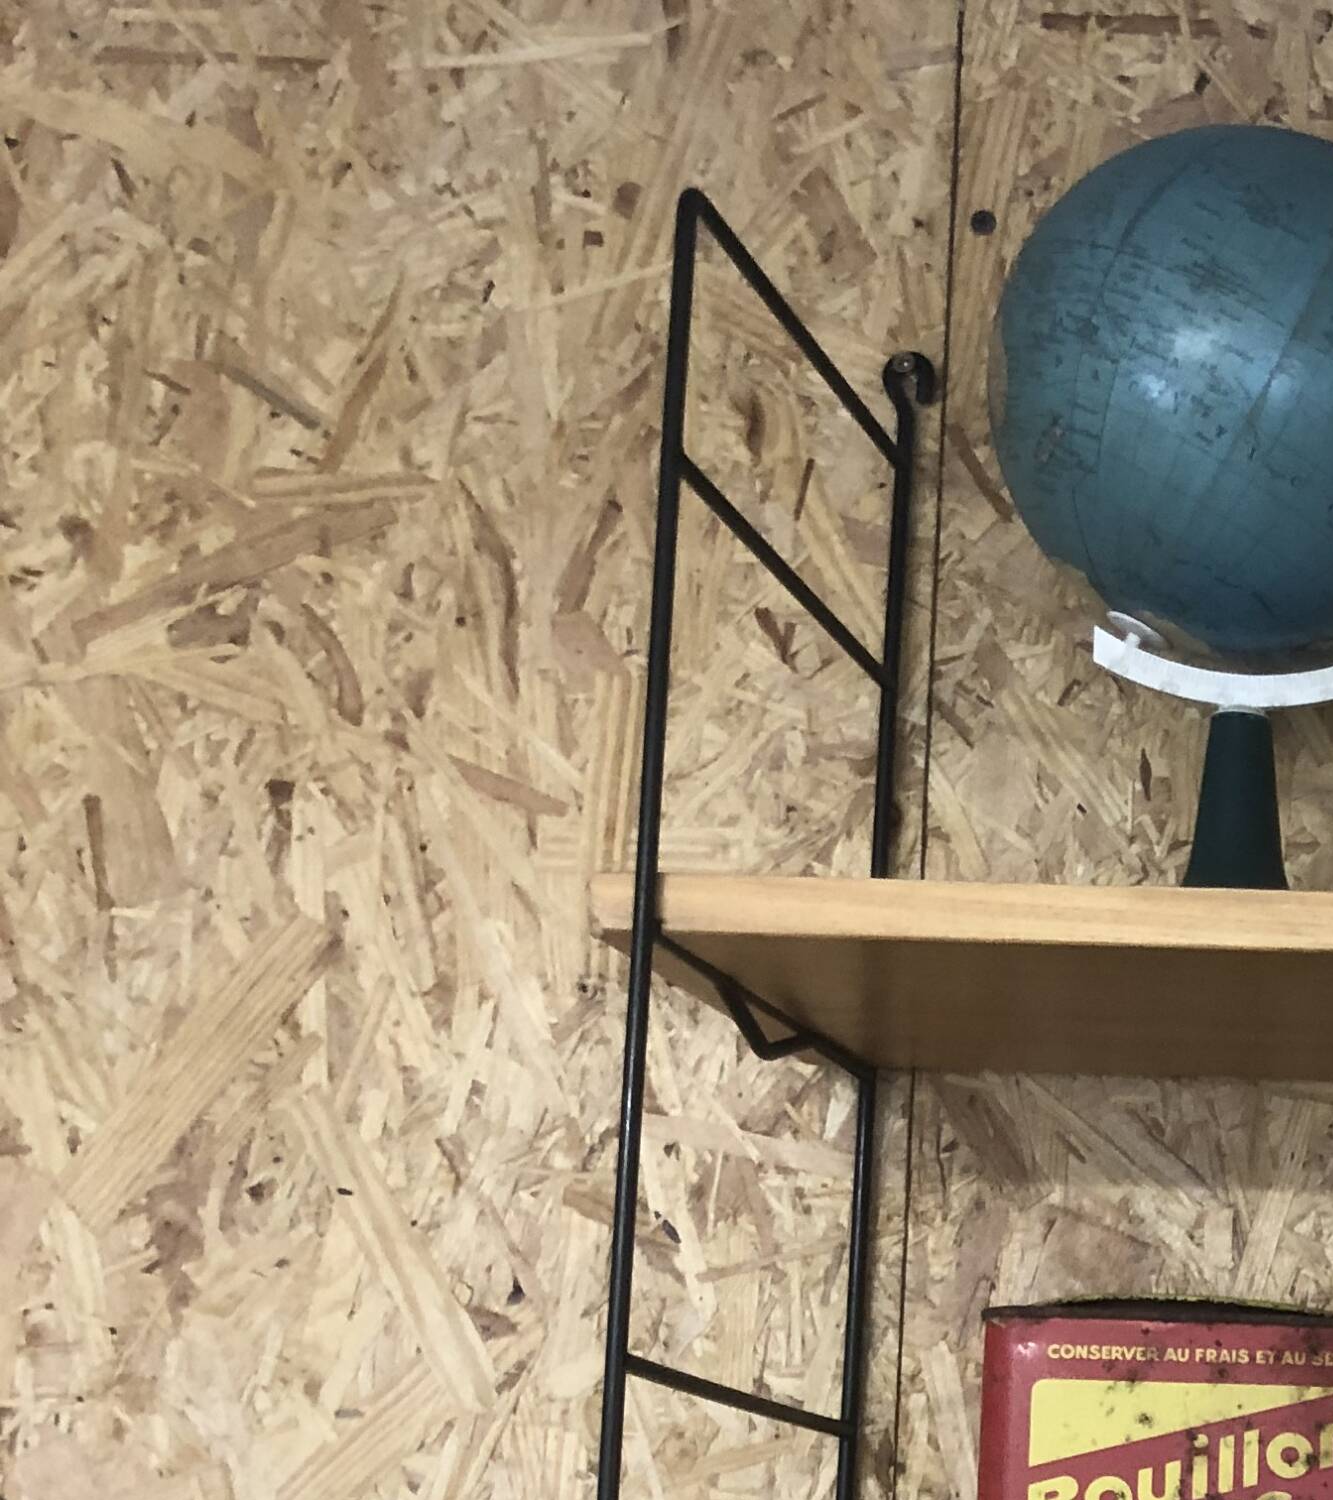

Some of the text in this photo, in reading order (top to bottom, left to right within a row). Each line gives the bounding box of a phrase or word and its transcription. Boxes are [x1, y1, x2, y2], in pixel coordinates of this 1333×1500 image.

[1047, 1344, 1159, 1362] CONSERVER
[1166, 1347, 1190, 1362] AU
[1195, 1349, 1249, 1364] FRAIS
[1256, 1350, 1278, 1365] ET
[1281, 1351, 1306, 1365] AU
